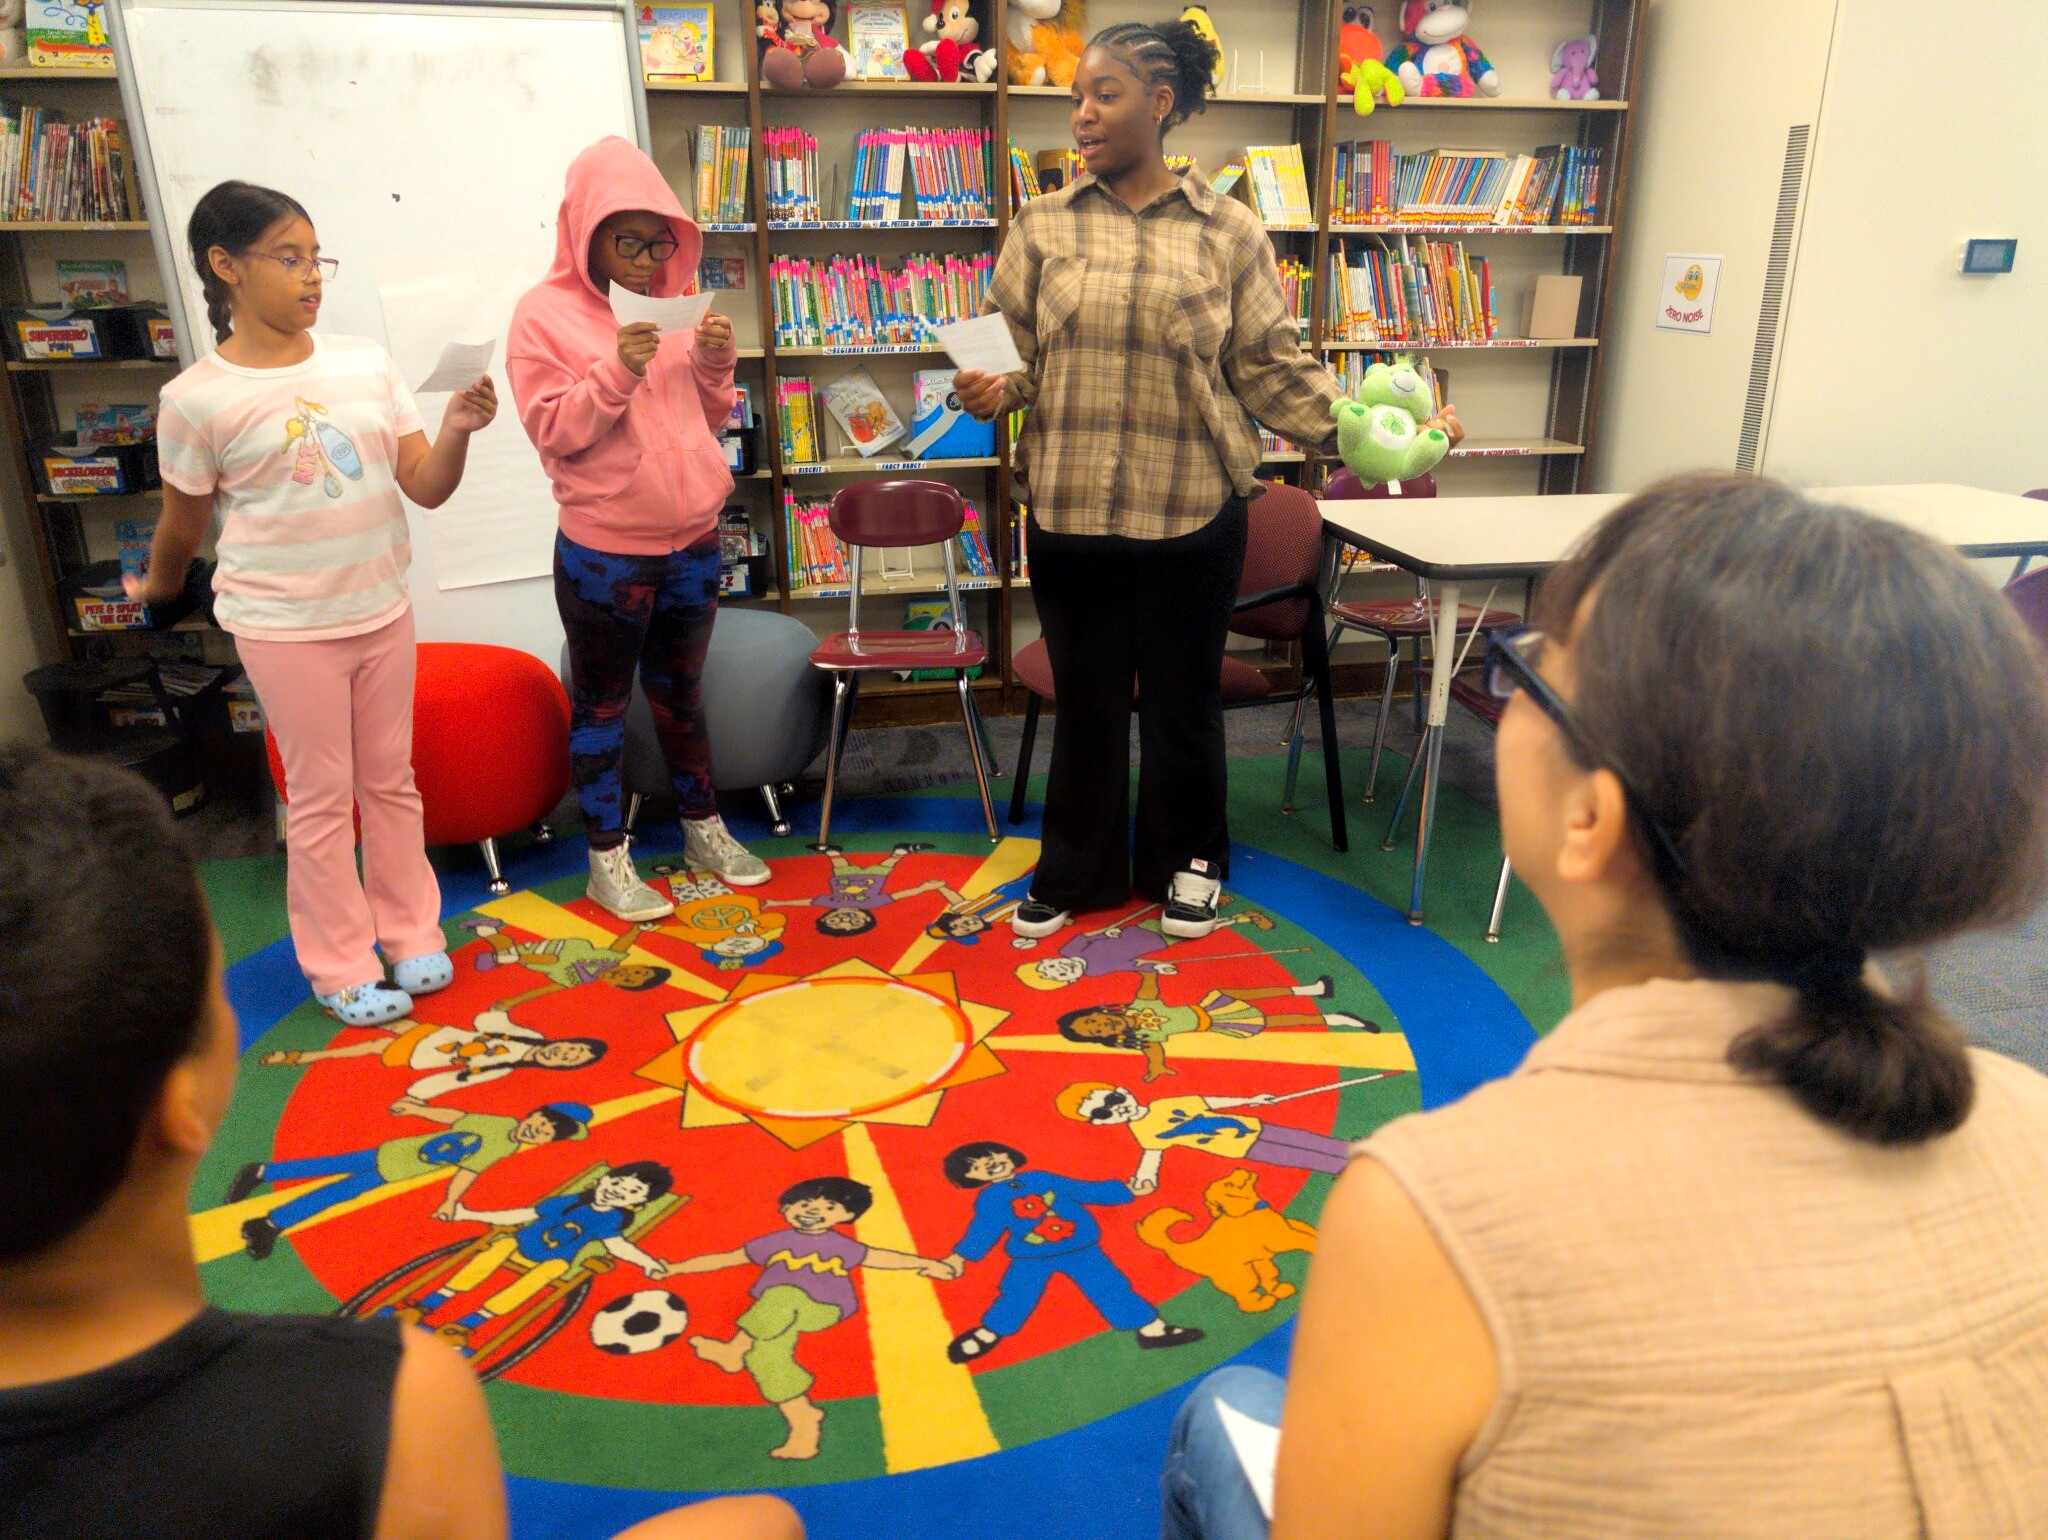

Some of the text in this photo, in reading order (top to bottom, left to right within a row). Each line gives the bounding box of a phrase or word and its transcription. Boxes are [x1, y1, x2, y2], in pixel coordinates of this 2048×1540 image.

[1665, 305, 1704, 323] ZERO NOISE
[28, 328, 88, 342] SUPERHERO
[52, 466, 116, 478] NICKELODEON
[85, 604, 104, 615] PETE
[100, 614, 134, 624] THE CAT
